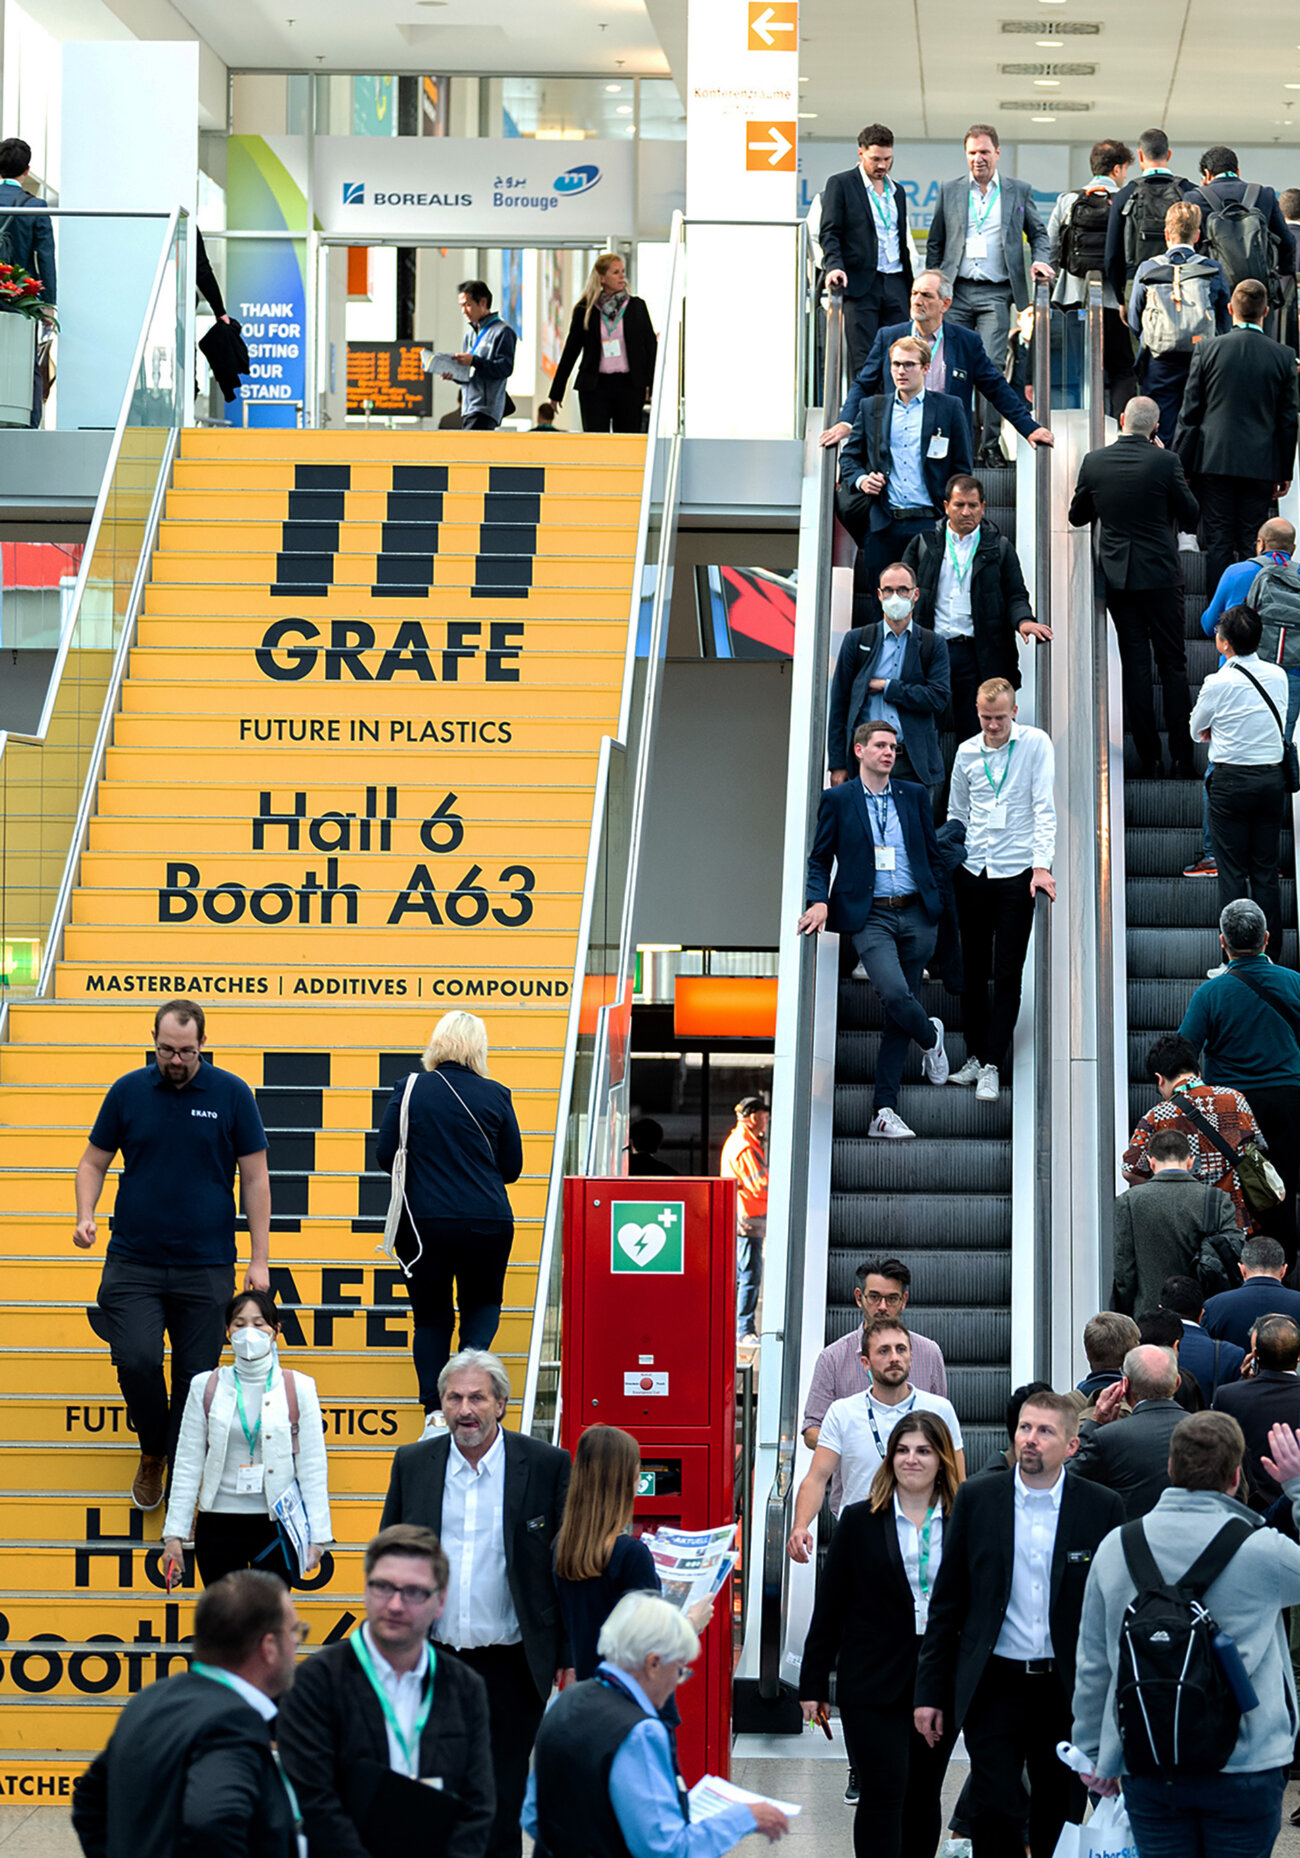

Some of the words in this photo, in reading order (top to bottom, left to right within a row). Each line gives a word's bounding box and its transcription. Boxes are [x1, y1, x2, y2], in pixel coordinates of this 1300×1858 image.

[374, 193, 472, 206] BOREALIS
[493, 192, 558, 211] Borouge
[240, 303, 293, 317] THANK
[242, 324, 264, 337] OU
[268, 324, 300, 337] FOR
[247, 344, 299, 358] SITING
[250, 364, 282, 378] OUR
[240, 385, 292, 398] STAND
[256, 617, 525, 682] GRAFE
[240, 718, 340, 742] FUTURE
[350, 719, 379, 743] IN
[390, 720, 513, 744] PLASTICS
[253, 786, 397, 852] Hall
[420, 793, 465, 854] 6
[158, 857, 359, 924] Booth
[387, 864, 536, 927] A63
[86, 975, 269, 995] MASTERBATCHES
[293, 977, 408, 997] ADDITIVES
[433, 979, 572, 998] COMPOUND
[256, 1267, 411, 1348] AFE
